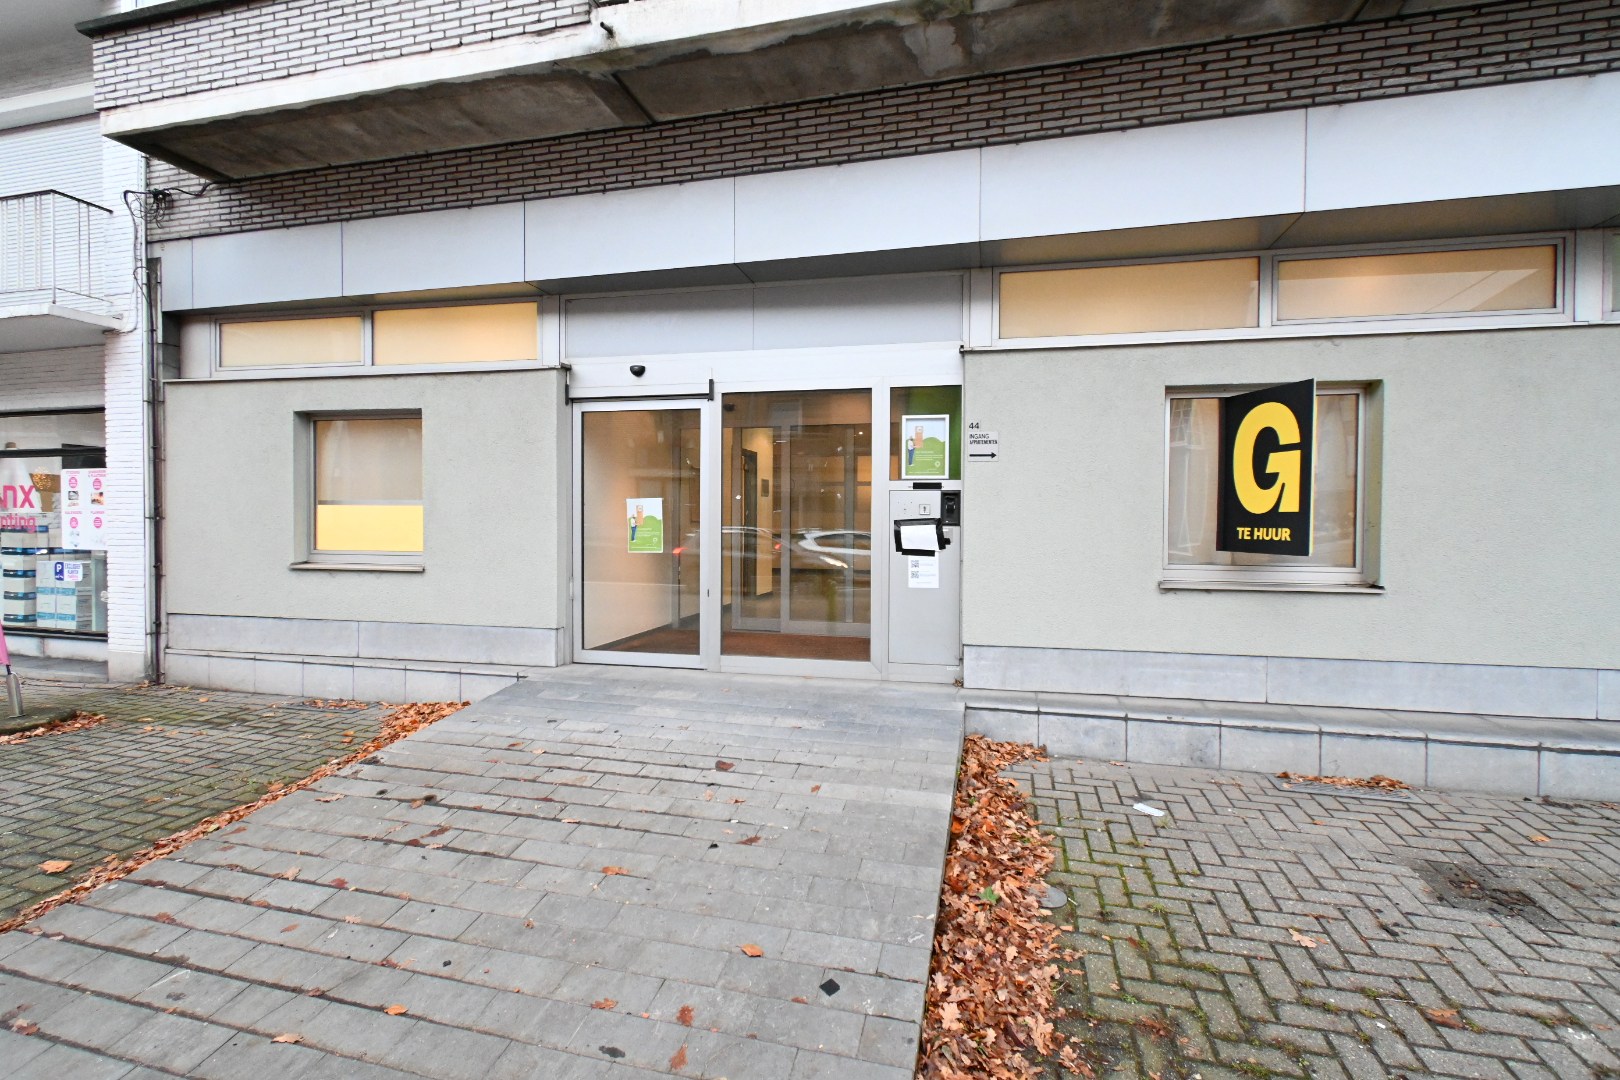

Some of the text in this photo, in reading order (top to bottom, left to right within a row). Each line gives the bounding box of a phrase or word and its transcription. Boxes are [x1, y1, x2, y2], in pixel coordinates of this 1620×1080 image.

[968, 422, 980, 430] 44
[1233, 401, 1302, 515] G
[1236, 527, 1291, 542] TE HUUR
